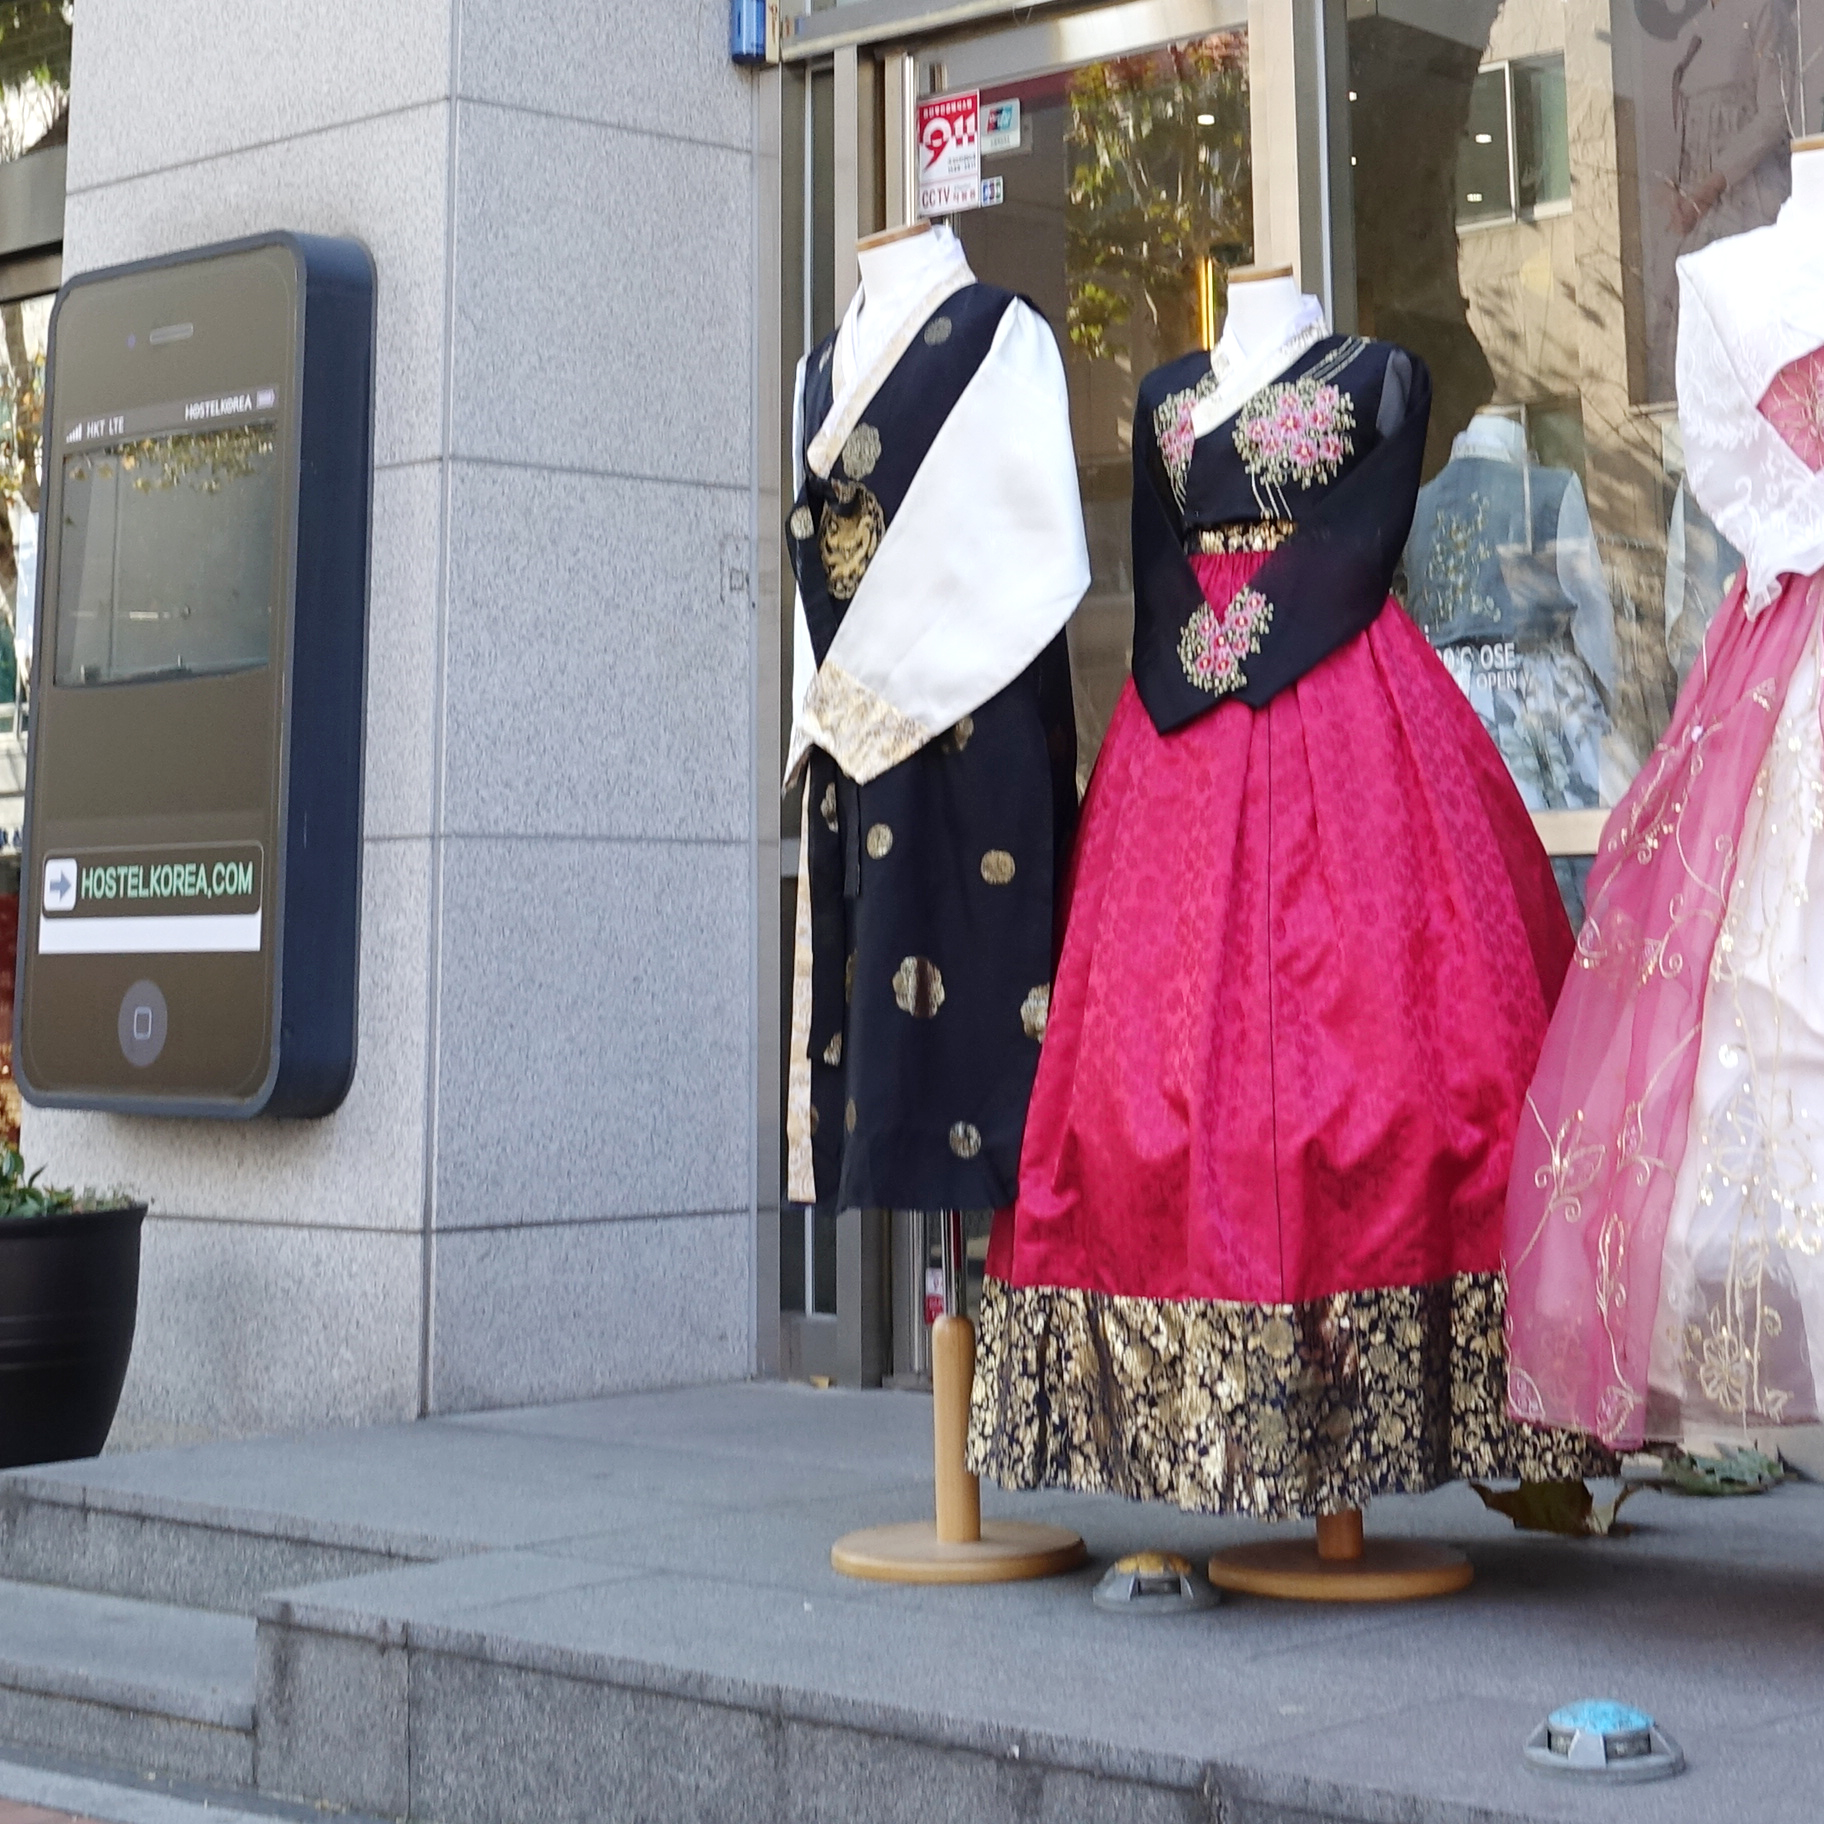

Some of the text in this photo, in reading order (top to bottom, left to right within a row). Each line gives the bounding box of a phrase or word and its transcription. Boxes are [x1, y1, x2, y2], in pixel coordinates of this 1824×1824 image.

[922, 185, 951, 210] CCTV
[184, 393, 253, 422] HOSTELKOREA
[108, 415, 124, 437] LTE
